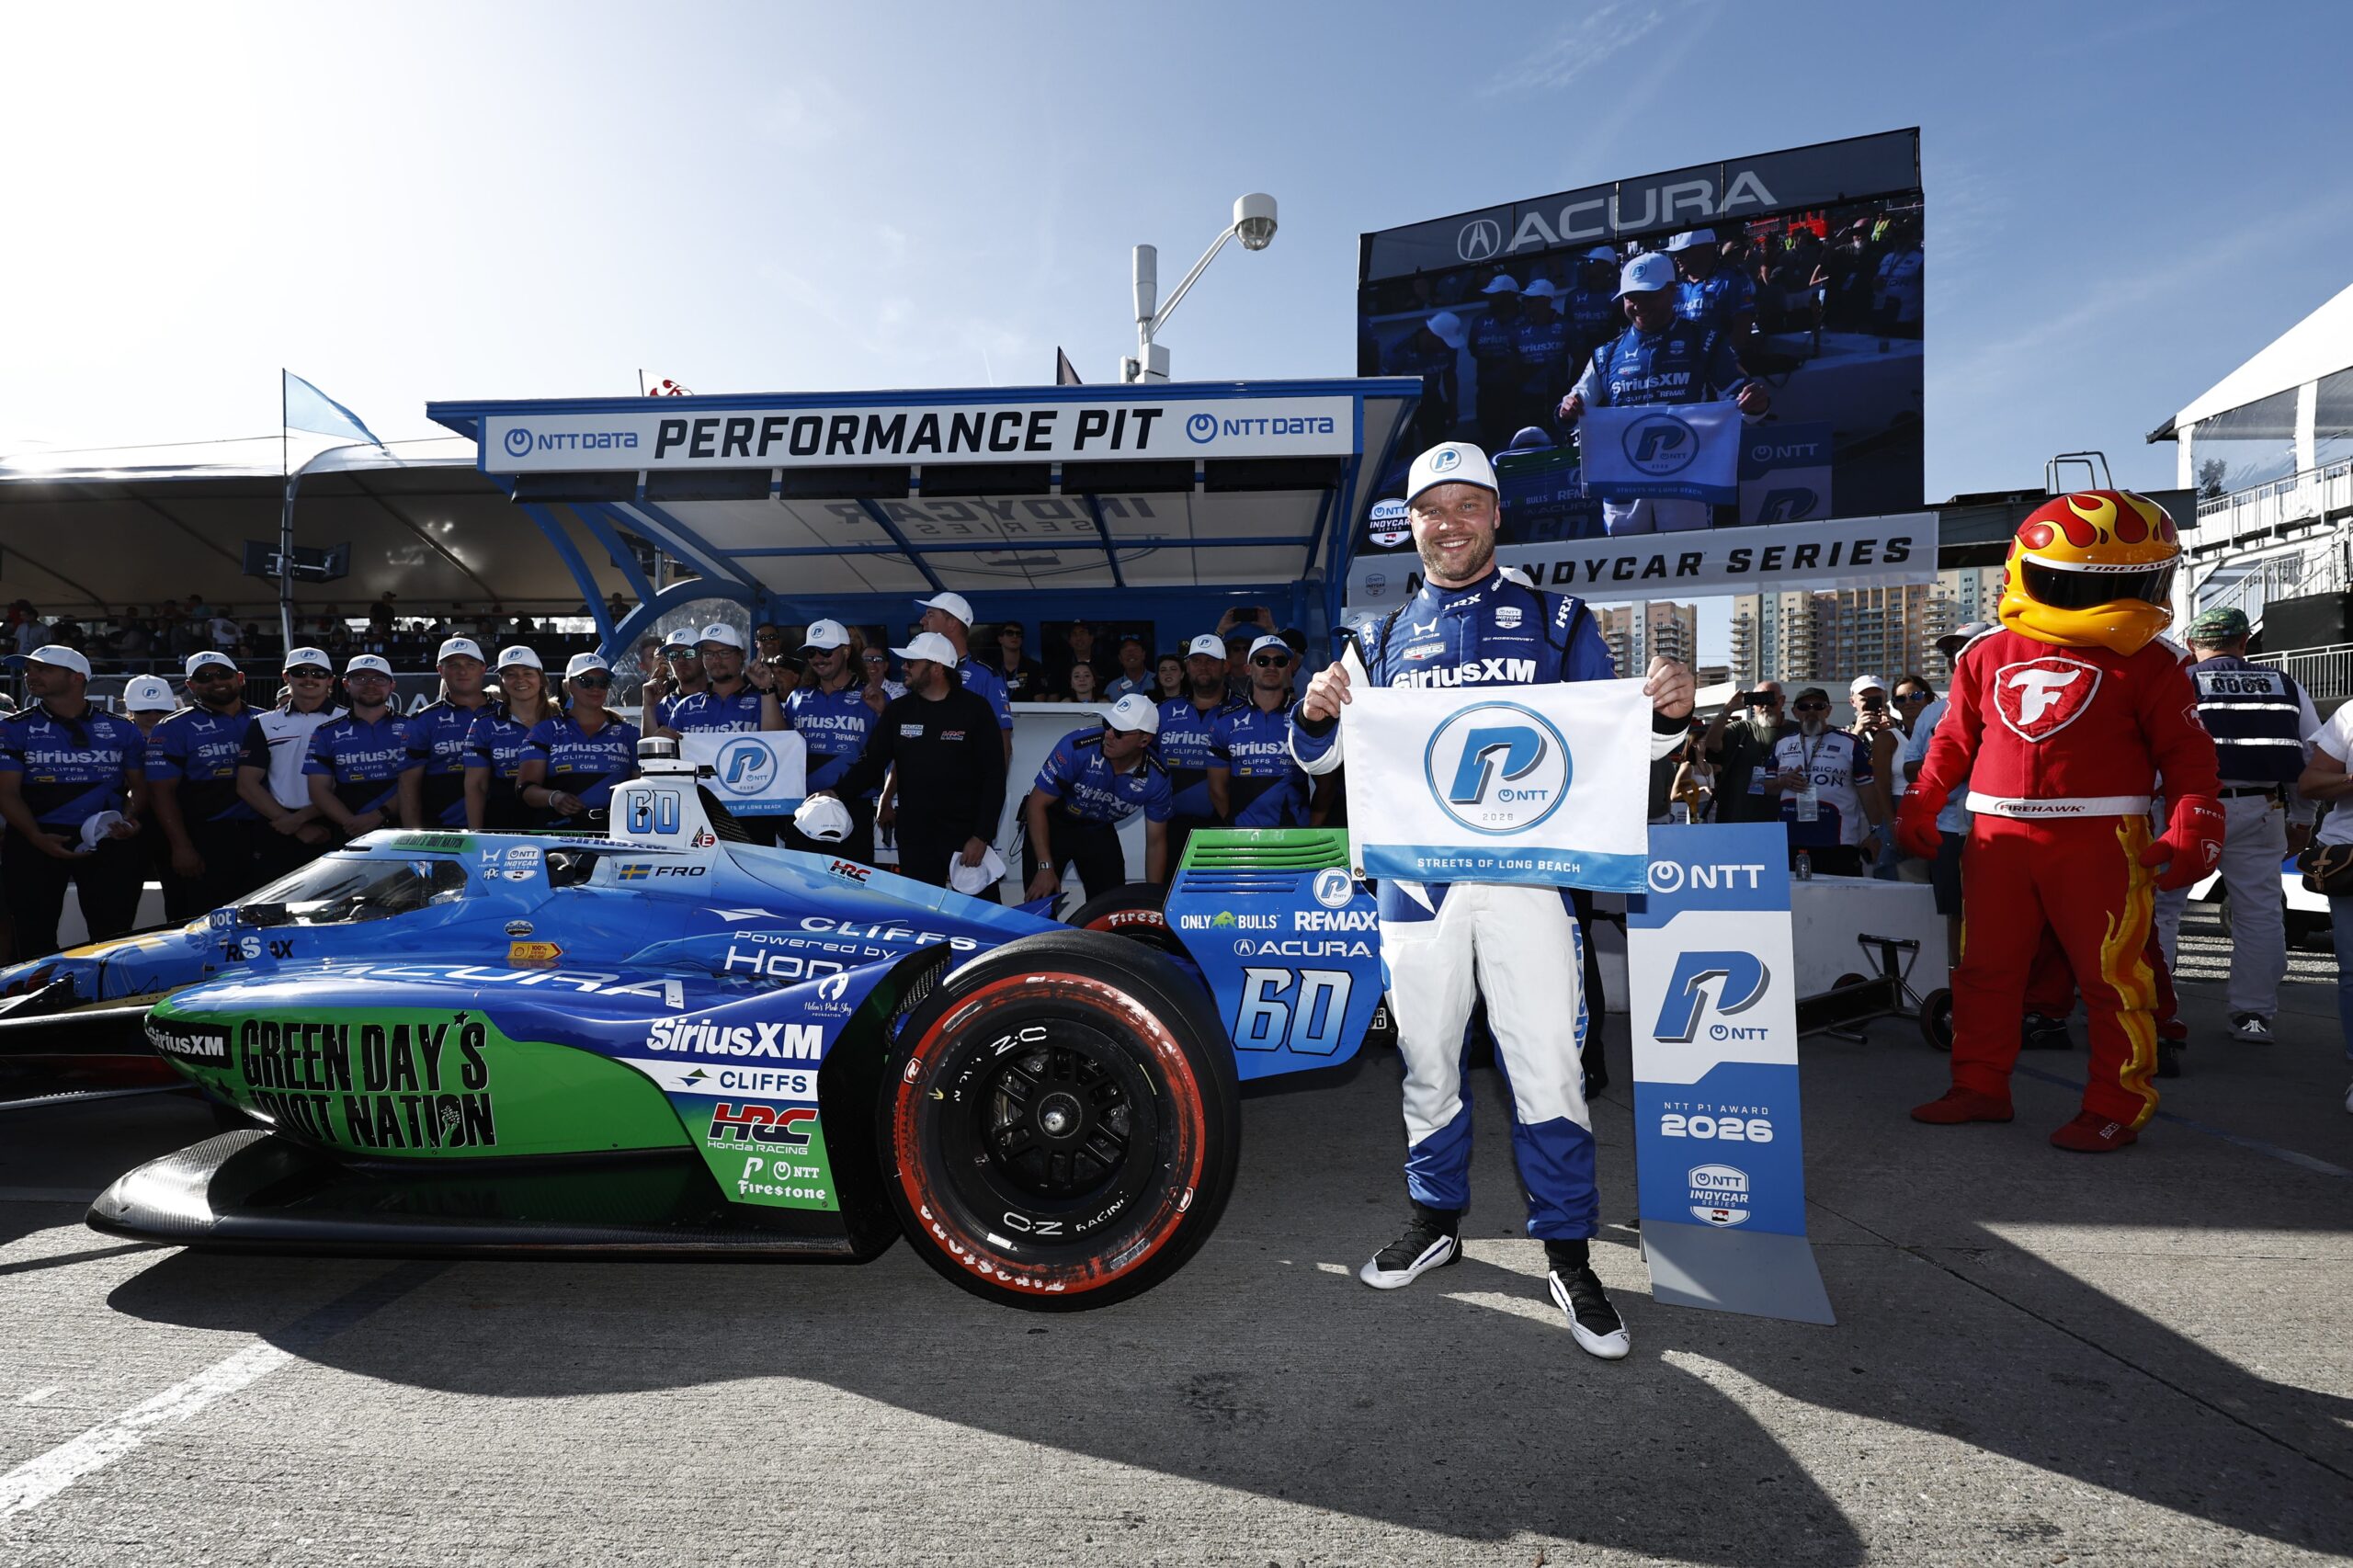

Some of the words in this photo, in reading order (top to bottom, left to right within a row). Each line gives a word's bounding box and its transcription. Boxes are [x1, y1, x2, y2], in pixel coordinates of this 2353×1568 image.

[1506, 171, 1779, 253] ACURA
[1611, 372, 1691, 394] SiriusXM
[539, 433, 579, 450] NTT
[654, 410, 1058, 459] PERFORMANCE
[1074, 408, 1164, 450] PIT
[1223, 418, 1269, 436] NTT
[1776, 443, 1819, 458] NTT
[1370, 517, 1412, 528] INDYCAR
[1509, 551, 1702, 585] NDYCAR
[1726, 536, 1913, 573] SERIES
[1392, 658, 1537, 687] SiriusXM
[1161, 731, 1211, 745] Sirius
[24, 750, 123, 764] SiriusXM
[335, 748, 399, 766] SiriusX
[551, 742, 630, 756] SiriusXM
[1228, 741, 1290, 756] SiriusX
[1517, 790, 1549, 801] NTT
[627, 790, 680, 835] 60
[2000, 804, 2083, 812] FIREHAWK
[654, 866, 707, 877] FRO
[1417, 858, 1472, 868] STREETS
[1478, 858, 1494, 868] OF
[1499, 859, 1532, 869] LONG
[1538, 860, 1581, 873] BEACH
[1691, 864, 1765, 889] NTT
[1180, 915, 1212, 929] ONLY
[1294, 911, 1379, 931] REMAX
[800, 916, 978, 951] CLIFFS
[734, 930, 858, 954] Powered
[864, 945, 897, 960] by
[1257, 940, 1373, 958] ACURA
[723, 946, 860, 980] Hon
[804, 1001, 824, 1012] Helen's
[825, 1001, 838, 1012] Pink
[840, 1002, 852, 1017] Sky
[1232, 967, 1354, 1057] 60
[146, 1026, 224, 1057] SiriusXM
[646, 1018, 824, 1060] SiriusXM
[1732, 1027, 1768, 1040] NTT
[241, 1018, 353, 1092] GREEN
[361, 1017, 489, 1092] DAY'S
[720, 1071, 807, 1093] CLIFFS
[1664, 1102, 1689, 1110] NTT
[1698, 1103, 1711, 1112] P1
[1720, 1105, 1768, 1115] AWARD
[343, 1092, 497, 1149] NATION
[707, 1102, 819, 1146] HRC
[1661, 1113, 1773, 1143] 2026
[708, 1141, 754, 1152] Honda
[756, 1144, 808, 1155] RACING
[794, 1166, 820, 1178] NTT
[737, 1179, 826, 1199] Firestone
[1712, 1176, 1742, 1187] NTT
[1689, 1189, 1749, 1203] INDYCAR
[1701, 1199, 1736, 1208] SERIES
